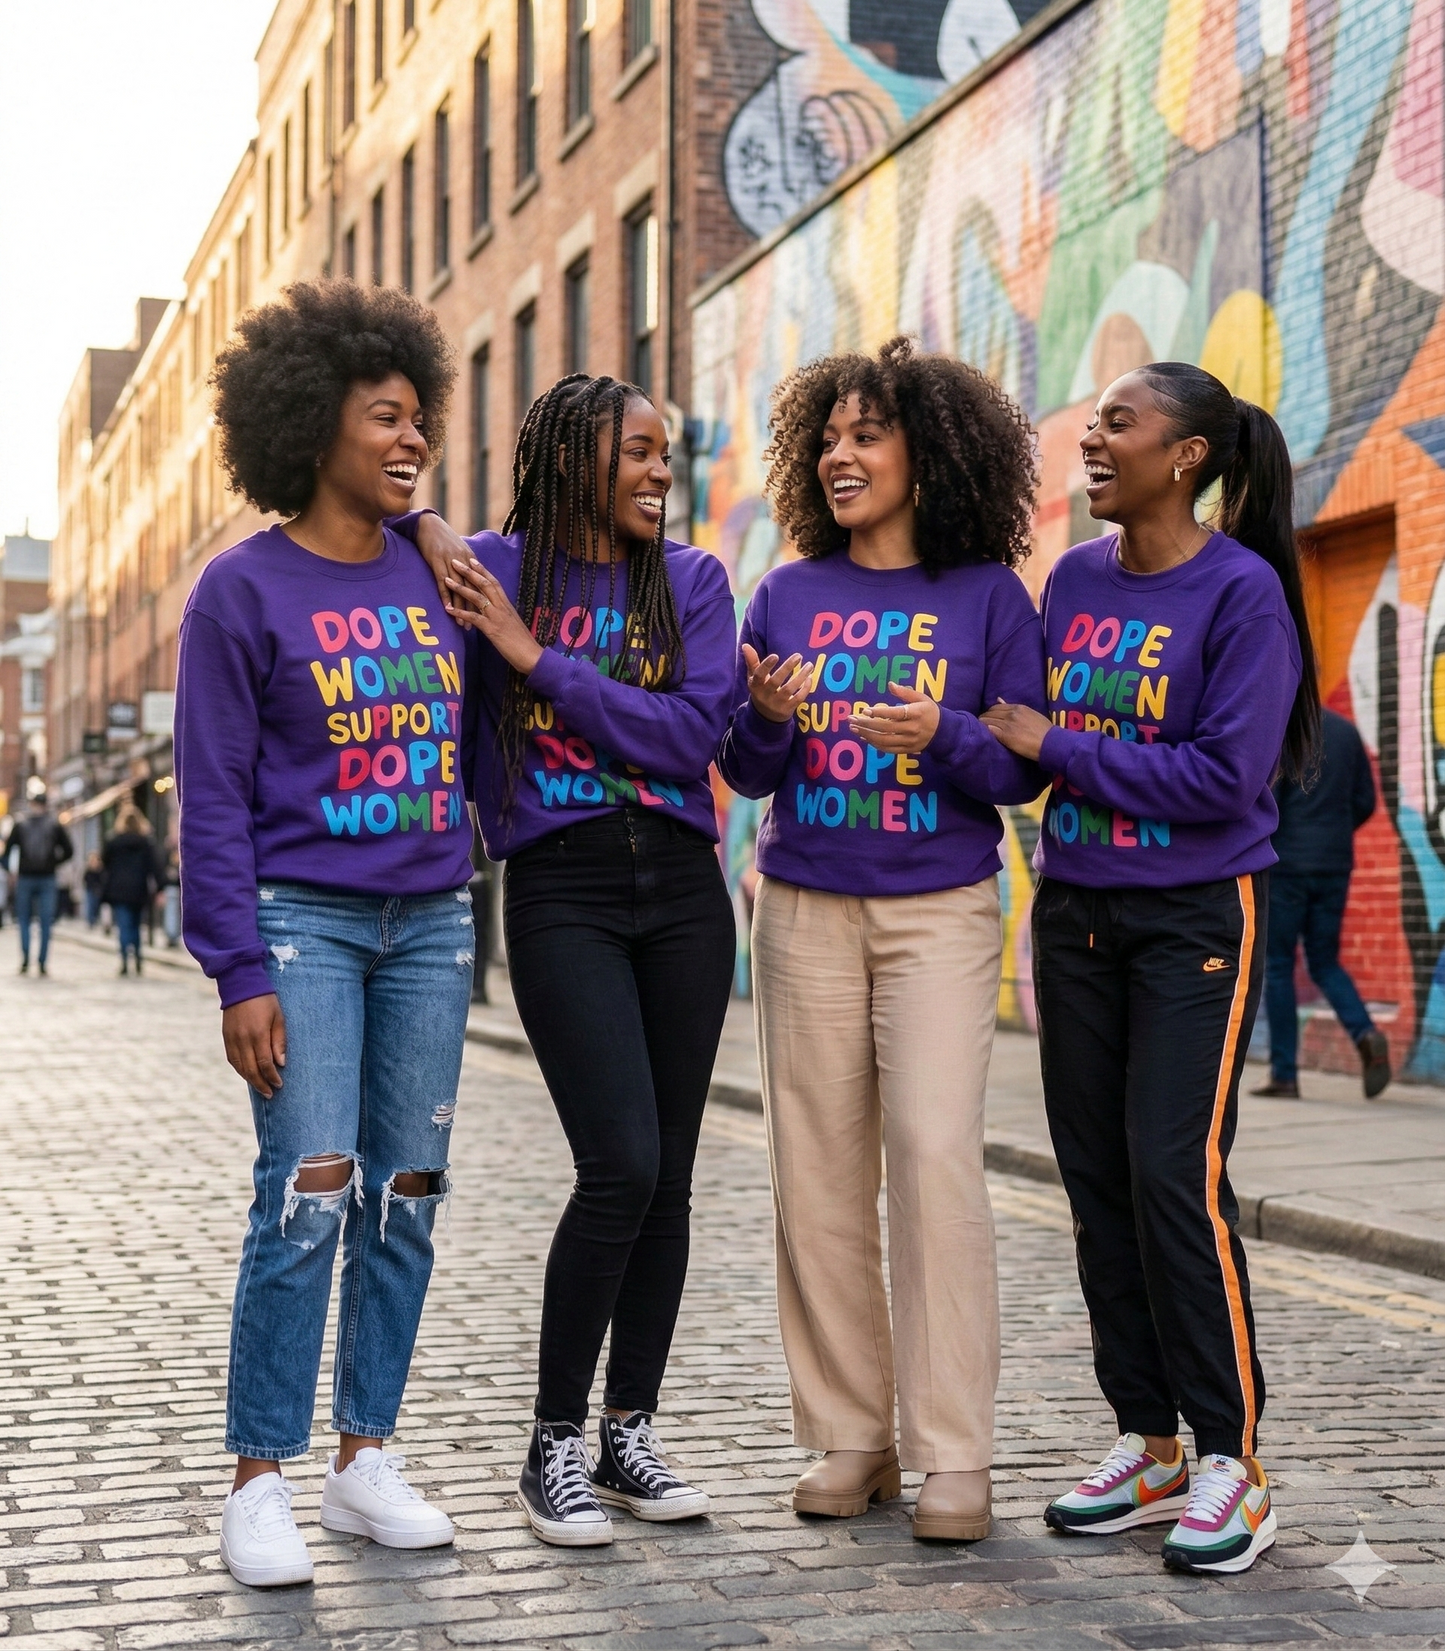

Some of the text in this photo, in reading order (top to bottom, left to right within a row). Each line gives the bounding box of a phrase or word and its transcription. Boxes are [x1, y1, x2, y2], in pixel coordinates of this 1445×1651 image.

[311, 606, 440, 653] DOPE
[808, 610, 939, 652] DOPE
[1061, 613, 1173, 668] DOPE
[310, 652, 461, 706] WOMEN
[1047, 656, 1170, 720] WOMEN
[327, 702, 460, 744] SUPPORT
[338, 740, 456, 790] DOPE
[805, 738, 924, 786] DOPE
[320, 790, 461, 836] WOMEN
[796, 783, 939, 833] WOMEN
